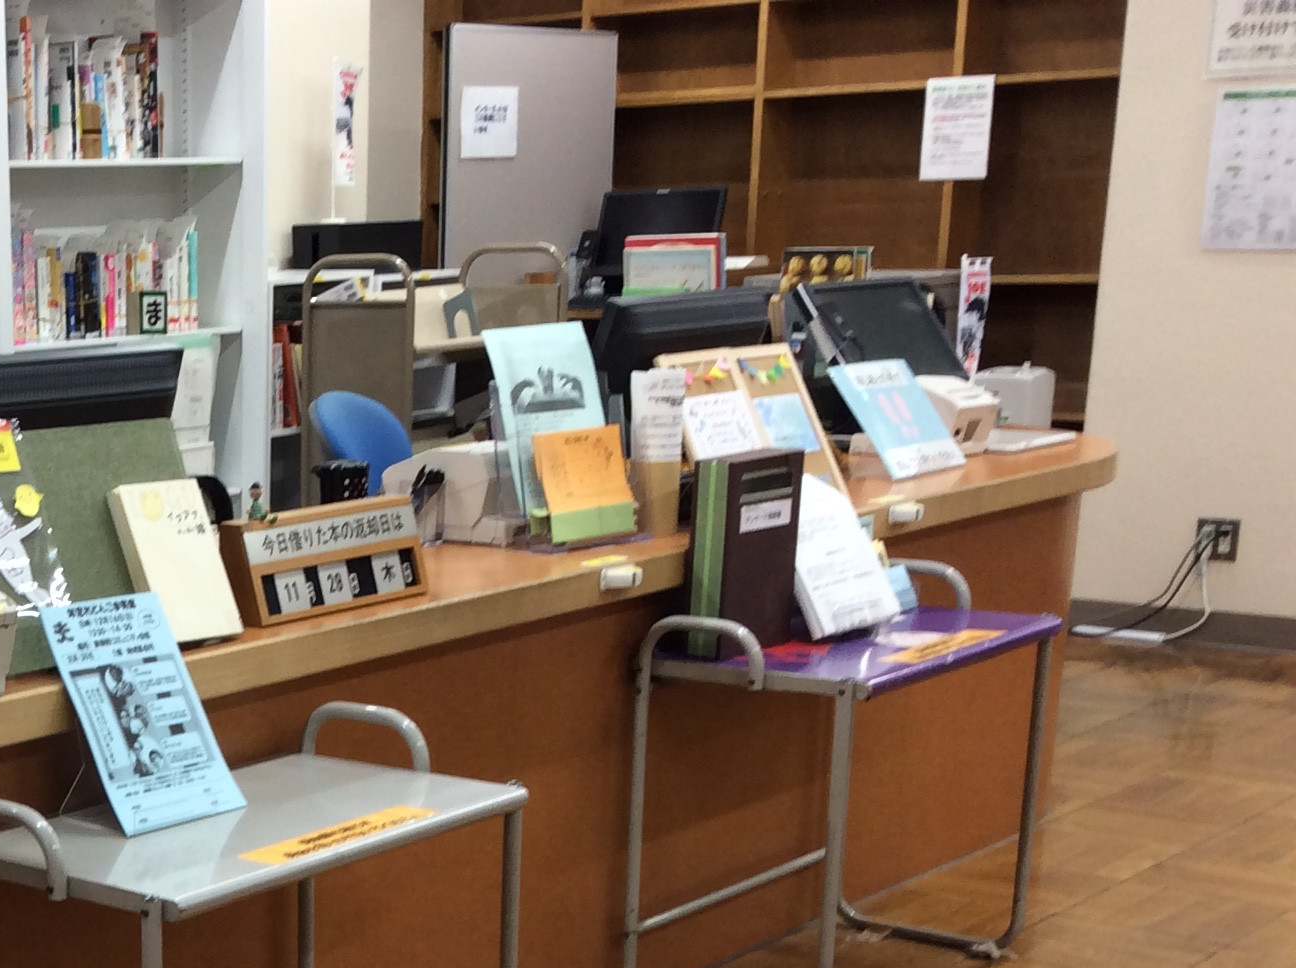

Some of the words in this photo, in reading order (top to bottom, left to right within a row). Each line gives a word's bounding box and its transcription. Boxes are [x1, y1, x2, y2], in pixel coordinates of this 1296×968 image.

[146, 298, 162, 326] ま
[262, 511, 405, 556] 今日借りた本の返却日は
[284, 581, 300, 603] 11
[381, 562, 397, 583] 木
